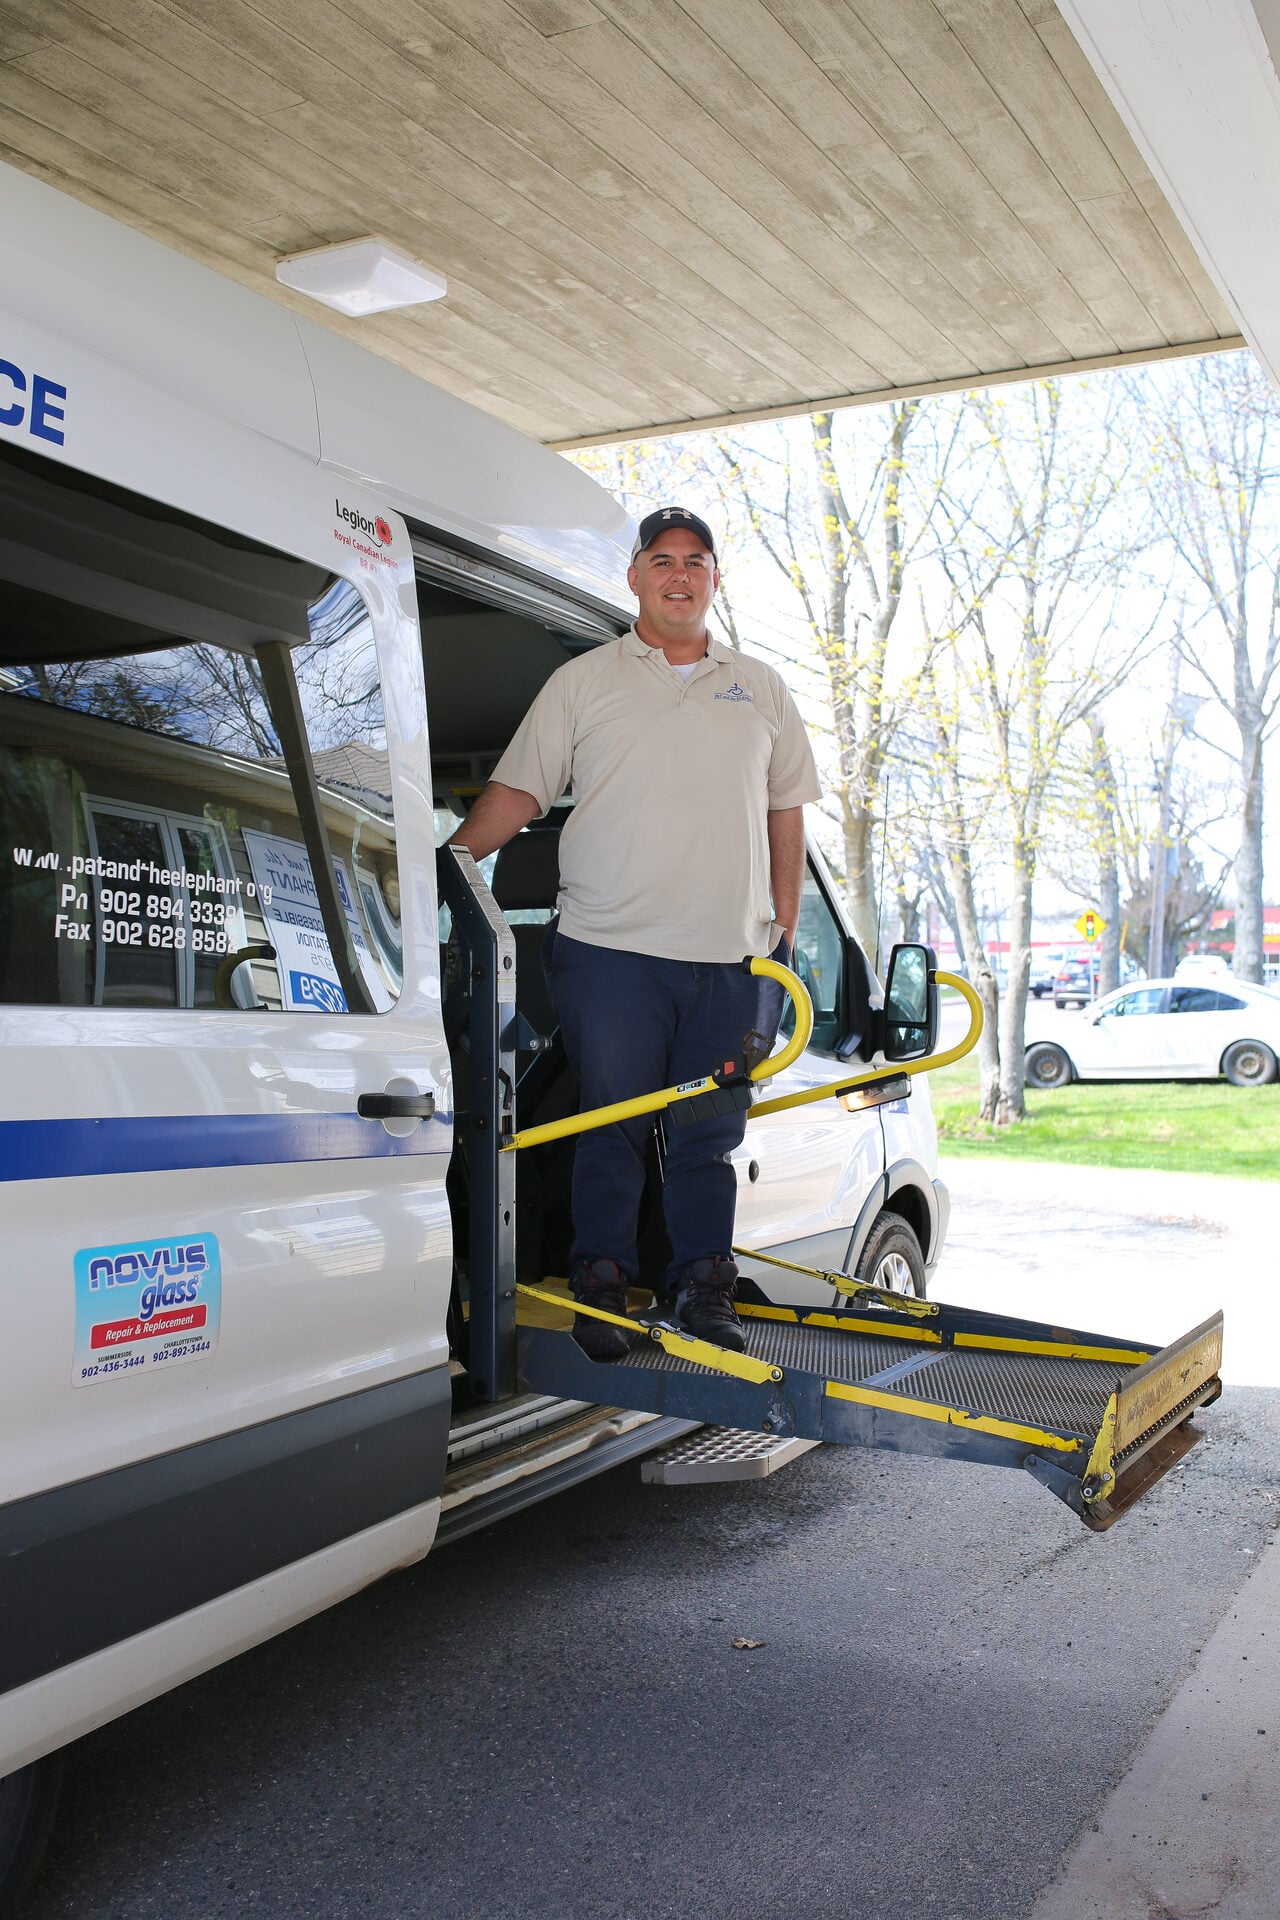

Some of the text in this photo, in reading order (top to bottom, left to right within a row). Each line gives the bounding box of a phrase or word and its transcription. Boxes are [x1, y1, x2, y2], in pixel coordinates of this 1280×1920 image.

[335, 498, 375, 535] Legion
[333, 529, 399, 570] Royal Canadian Legion
[100, 889, 141, 916] 902
[146, 894, 184, 921] 894
[55, 914, 91, 941] Fax
[102, 919, 143, 946] 902
[148, 924, 187, 950] 628
[139, 1273, 198, 1319] glass
[105, 1313, 194, 1341] Repair & Replacement
[163, 1335, 203, 1348] CHARLOTTETOWN
[97, 1350, 132, 1363] SUMMERSIDE
[152, 1340, 211, 1362] 902-892-3444
[81, 1355, 145, 1378] 902-436-3444
